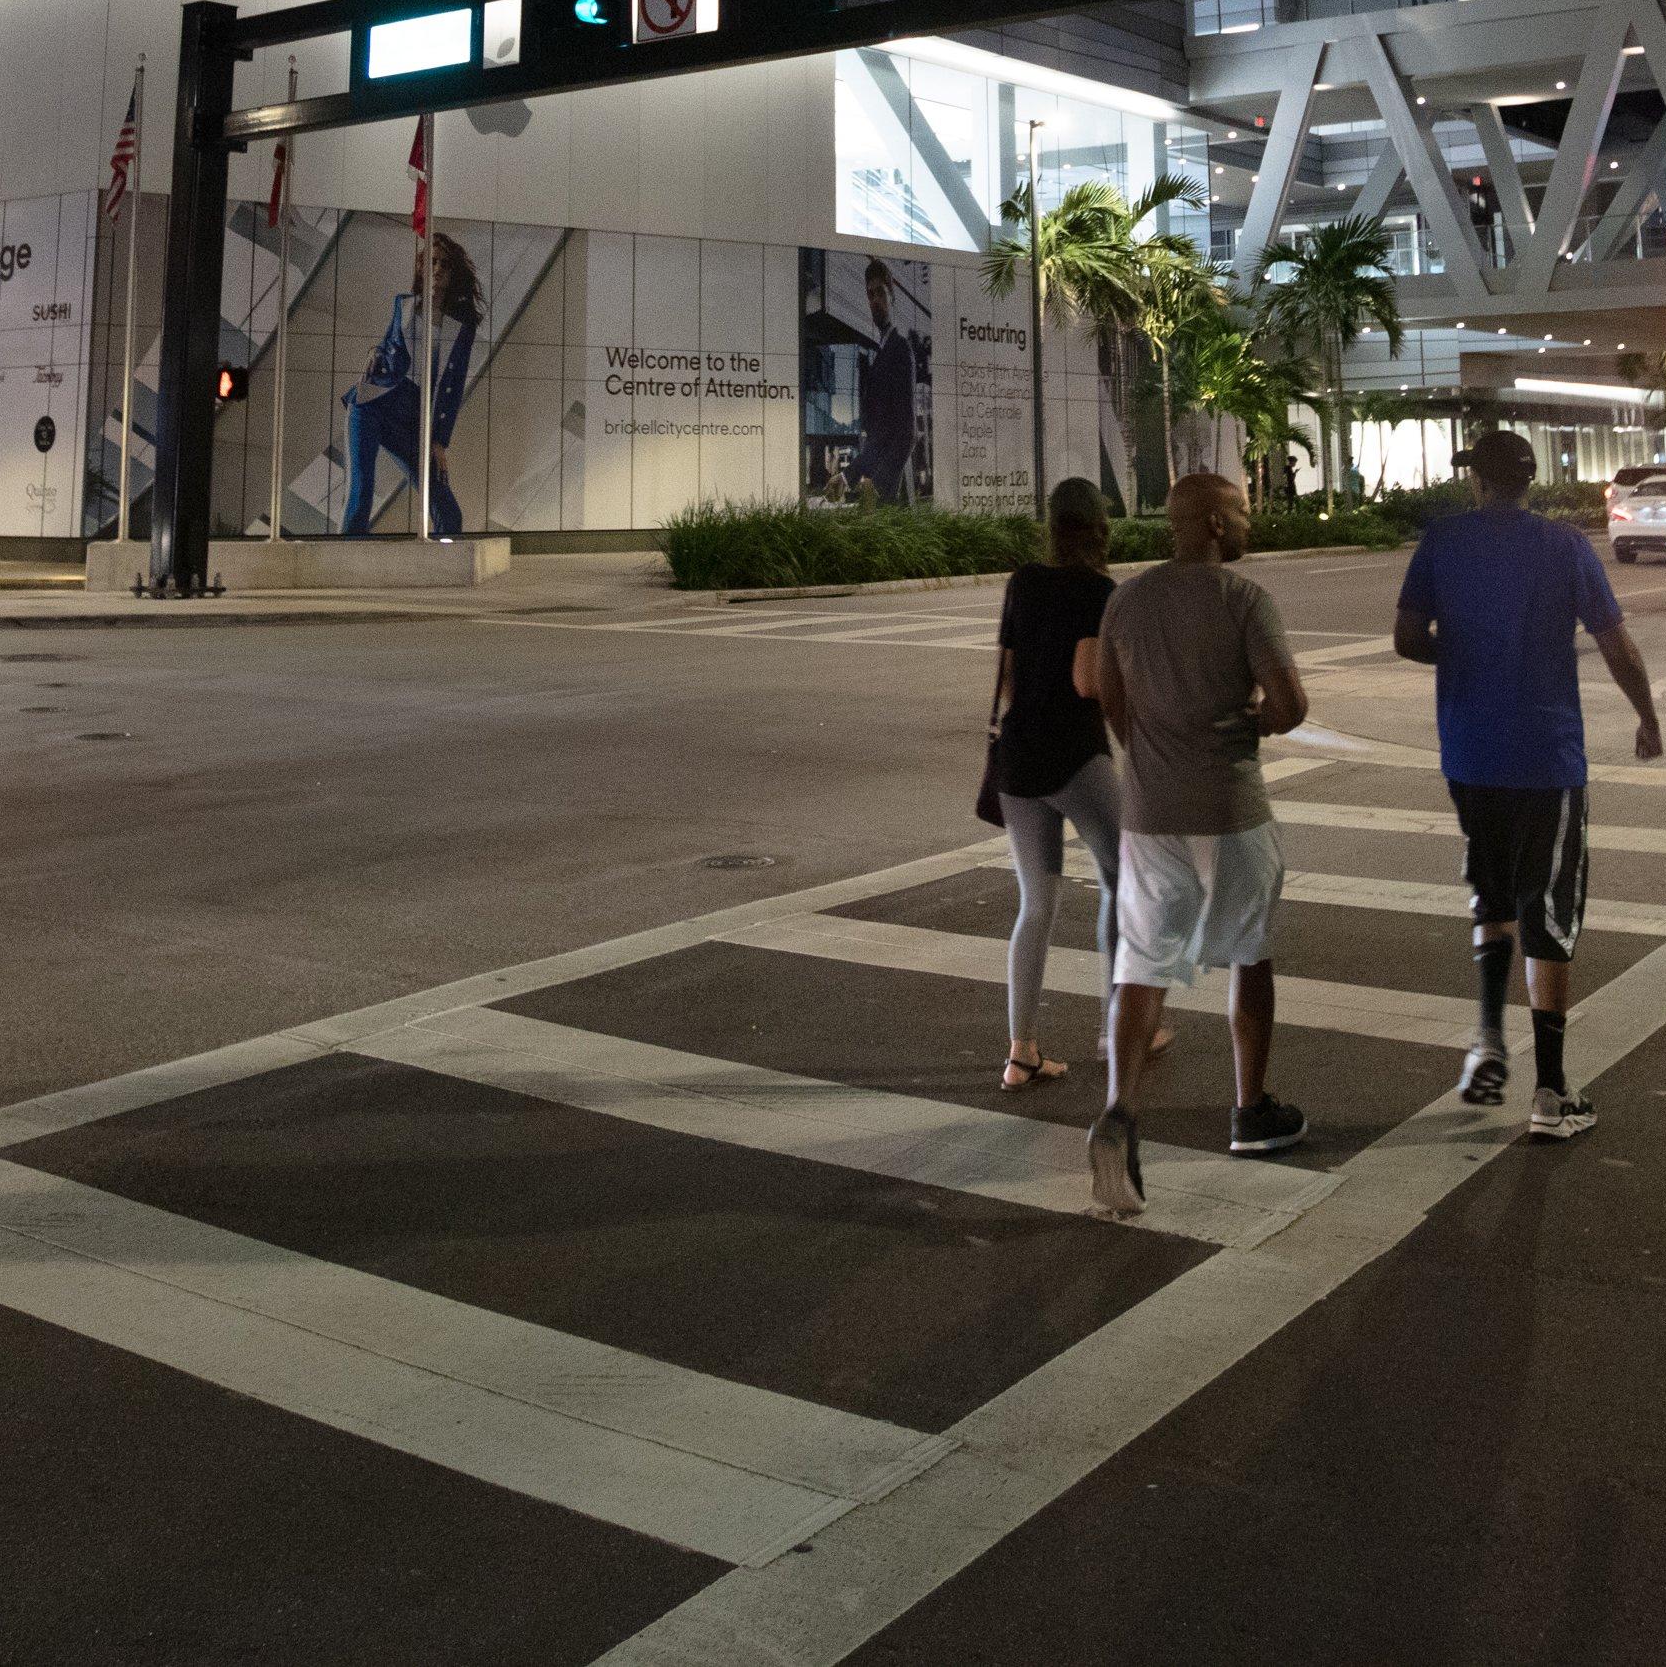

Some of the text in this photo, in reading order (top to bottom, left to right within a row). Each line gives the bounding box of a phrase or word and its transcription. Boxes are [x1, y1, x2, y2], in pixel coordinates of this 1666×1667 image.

[33, 303, 72, 321] SUSHI
[959, 317, 1026, 351] Featuring
[605, 346, 760, 373] Welcome to the
[604, 374, 795, 400] Centre of Attention.
[604, 419, 764, 439] brickellcitycentre.com
[962, 470, 1029, 487] and over 120
